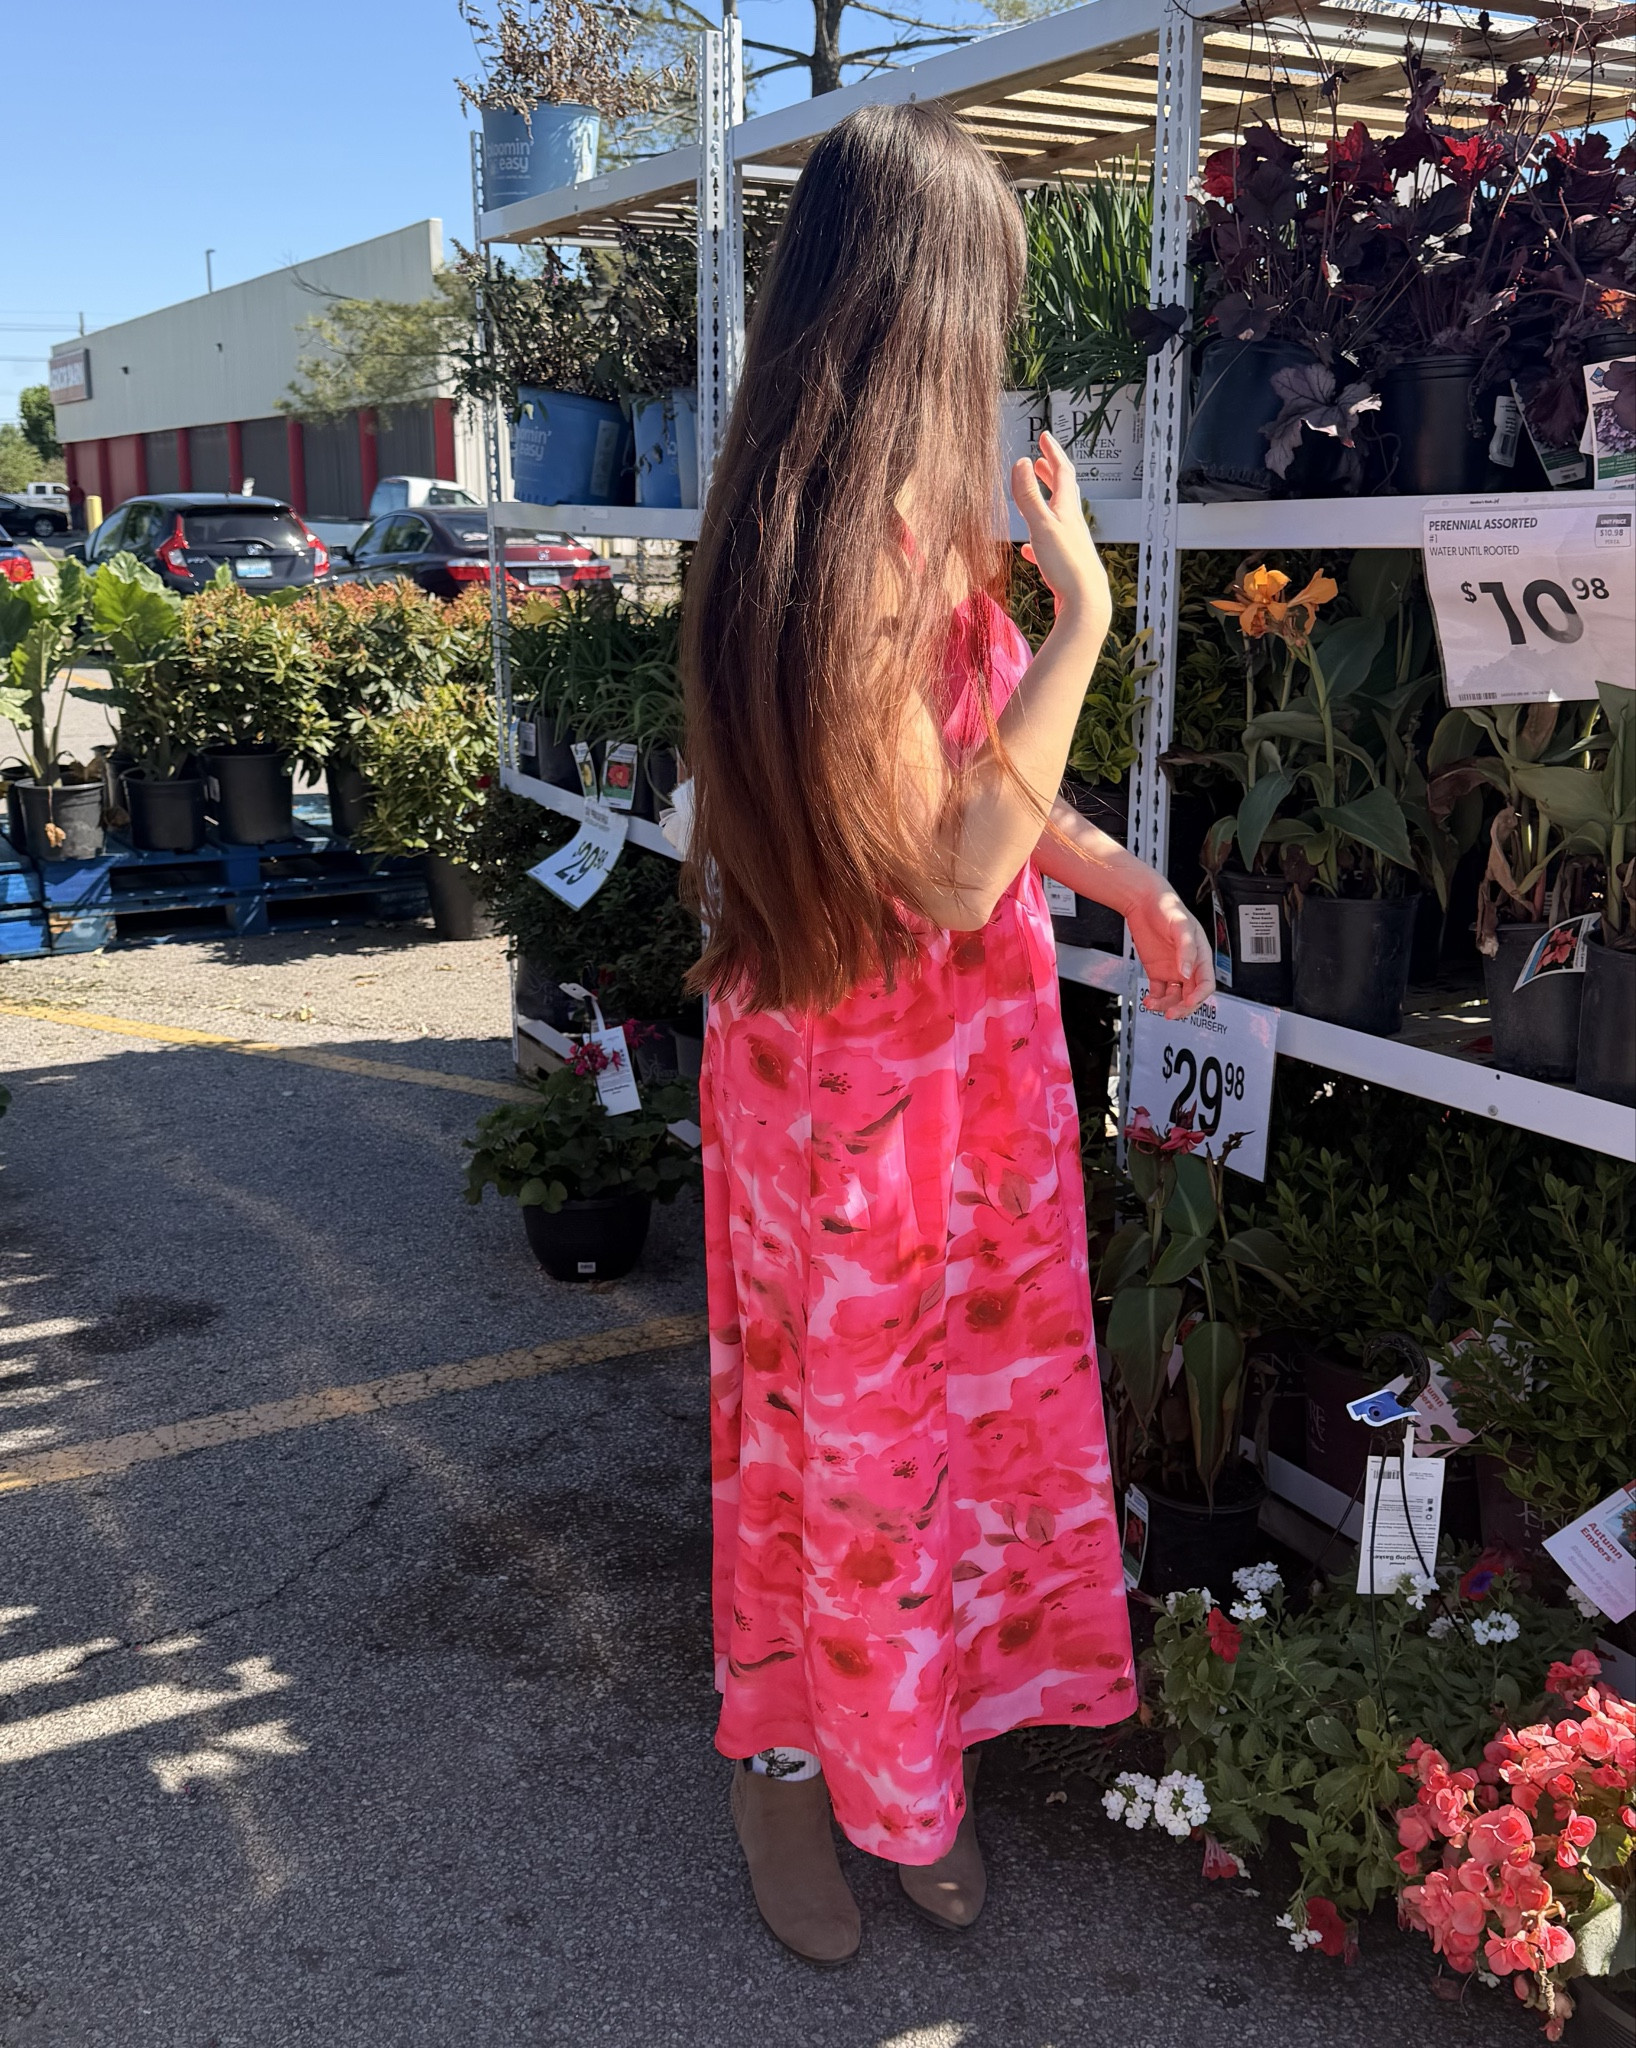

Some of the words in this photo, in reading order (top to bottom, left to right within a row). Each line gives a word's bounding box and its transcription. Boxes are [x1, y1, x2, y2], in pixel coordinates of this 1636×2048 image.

[499, 157, 529, 173] easy
[1428, 518, 1483, 532] PERENNIAL
[1483, 516, 1539, 530] ASSORTED
[1600, 528, 1624, 537] $10.98
[1429, 546, 1458, 556] WATER
[1458, 545, 1483, 556] UNTIL
[1483, 544, 1520, 556] ROOTED
[1190, 1017, 1228, 1035] NURSERY
[1588, 1522, 1623, 1559] Autumn
